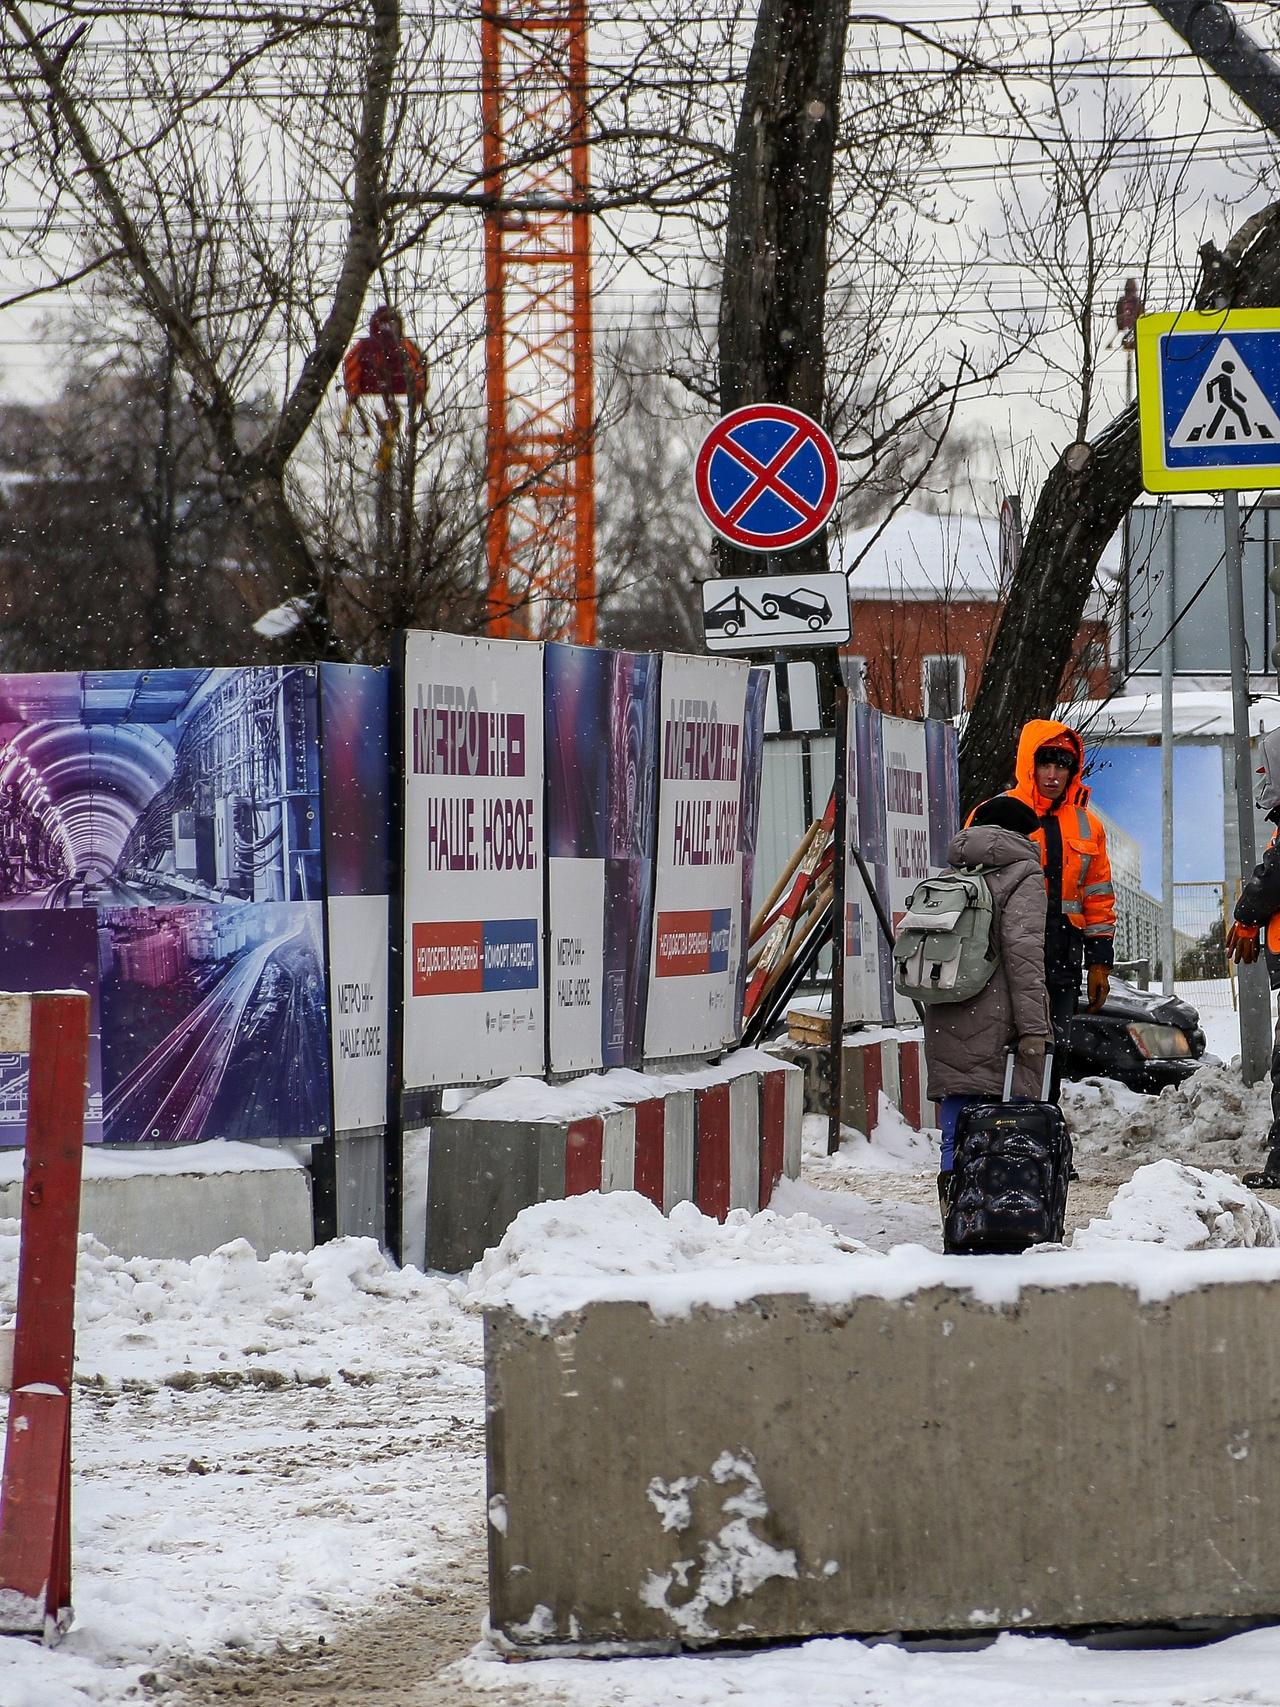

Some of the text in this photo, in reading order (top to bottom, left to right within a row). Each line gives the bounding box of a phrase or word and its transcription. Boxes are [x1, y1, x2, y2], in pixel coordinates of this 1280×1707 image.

[417, 683, 480, 776] МЕТРО
[488, 711, 509, 777] НН
[667, 698, 718, 781] МЕТРО
[719, 723, 733, 782] НН
[428, 797, 538, 872] НАШЕ. НОВОЕ.
[673, 799, 713, 867] НАШЕ.
[337, 983, 361, 1014] МЕТРО
